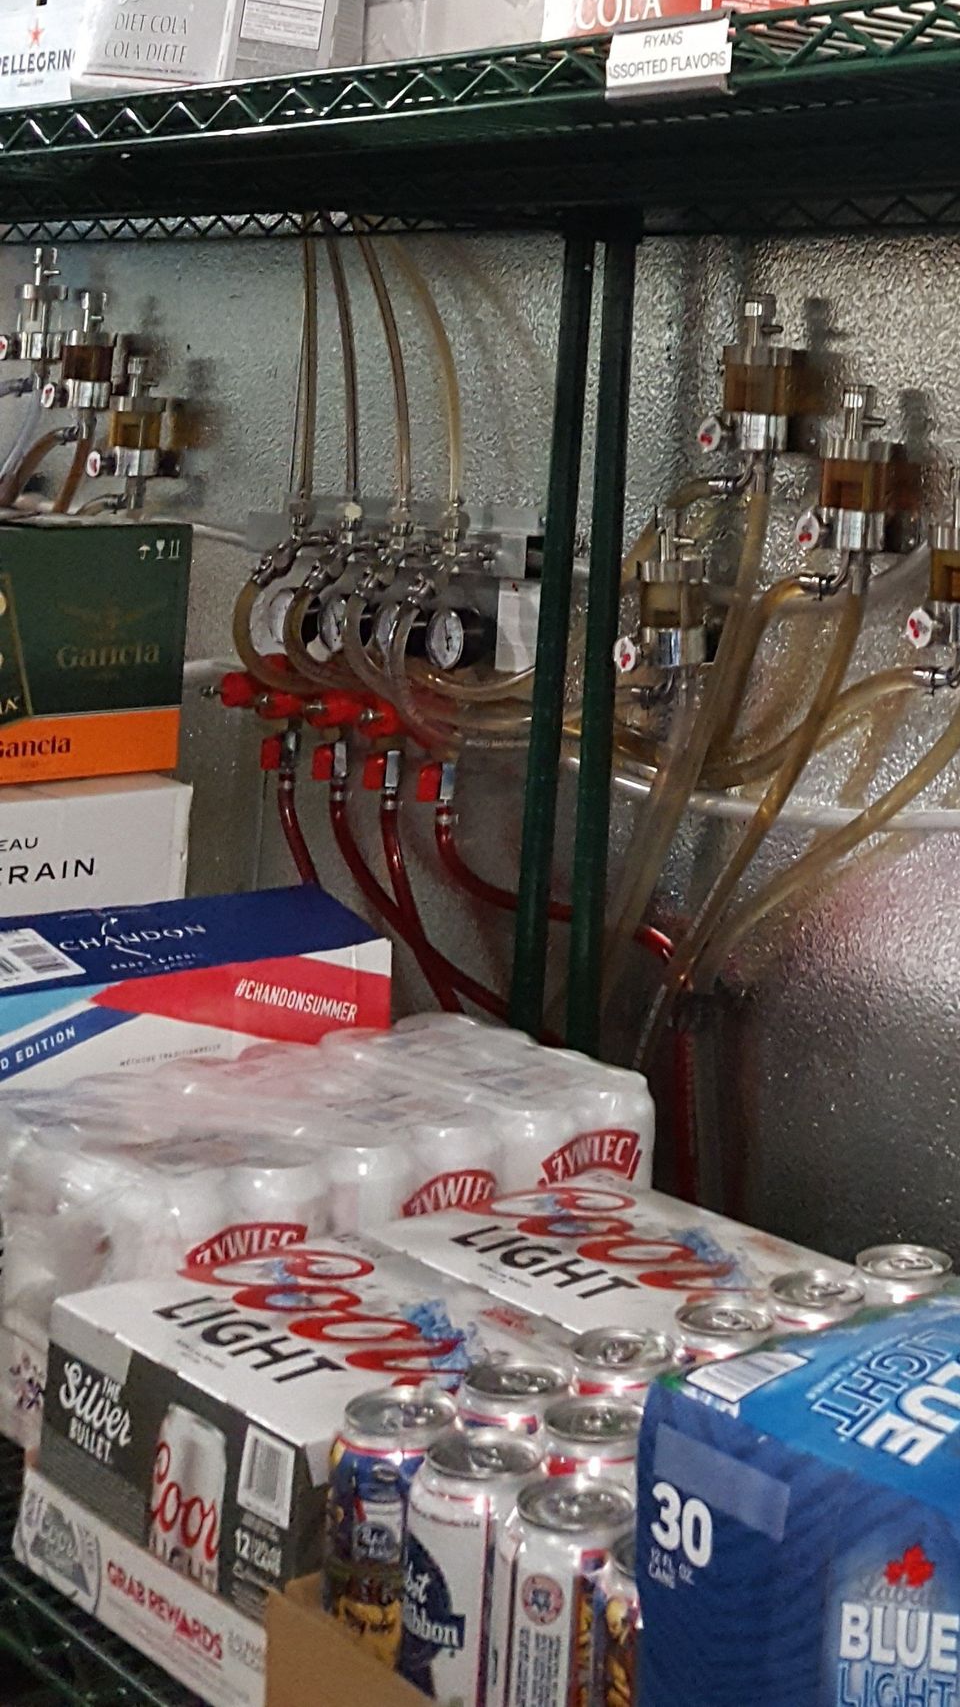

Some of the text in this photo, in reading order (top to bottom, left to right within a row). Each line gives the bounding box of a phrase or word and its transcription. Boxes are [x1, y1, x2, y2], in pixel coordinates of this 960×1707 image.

[114, 12, 188, 35] DIET COLA
[643, 30, 684, 49] RYANS
[0, 48, 76, 77] ELLEGRIN
[104, 40, 188, 65] COLA DIETE
[671, 50, 727, 72] FLAVORS
[56, 643, 161, 670] Gancia
[0, 857, 96, 886] RAIN
[59, 923, 207, 952] CHANDON
[235, 978, 358, 1023] #CHANDONSUMMER
[15, 1026, 77, 1063] EDITION
[451, 1224, 644, 1300] LIGHT
[153, 1296, 349, 1385] LIGHT
[59, 1361, 133, 1447] Silver
[102, 1375, 123, 1403] THE
[811, 1328, 956, 1443] LIGHT
[68, 1416, 114, 1465] BULLET
[650, 1481, 713, 1568] 30
[839, 1602, 960, 1675] BLUE
[837, 1662, 958, 1707] LIGHT
